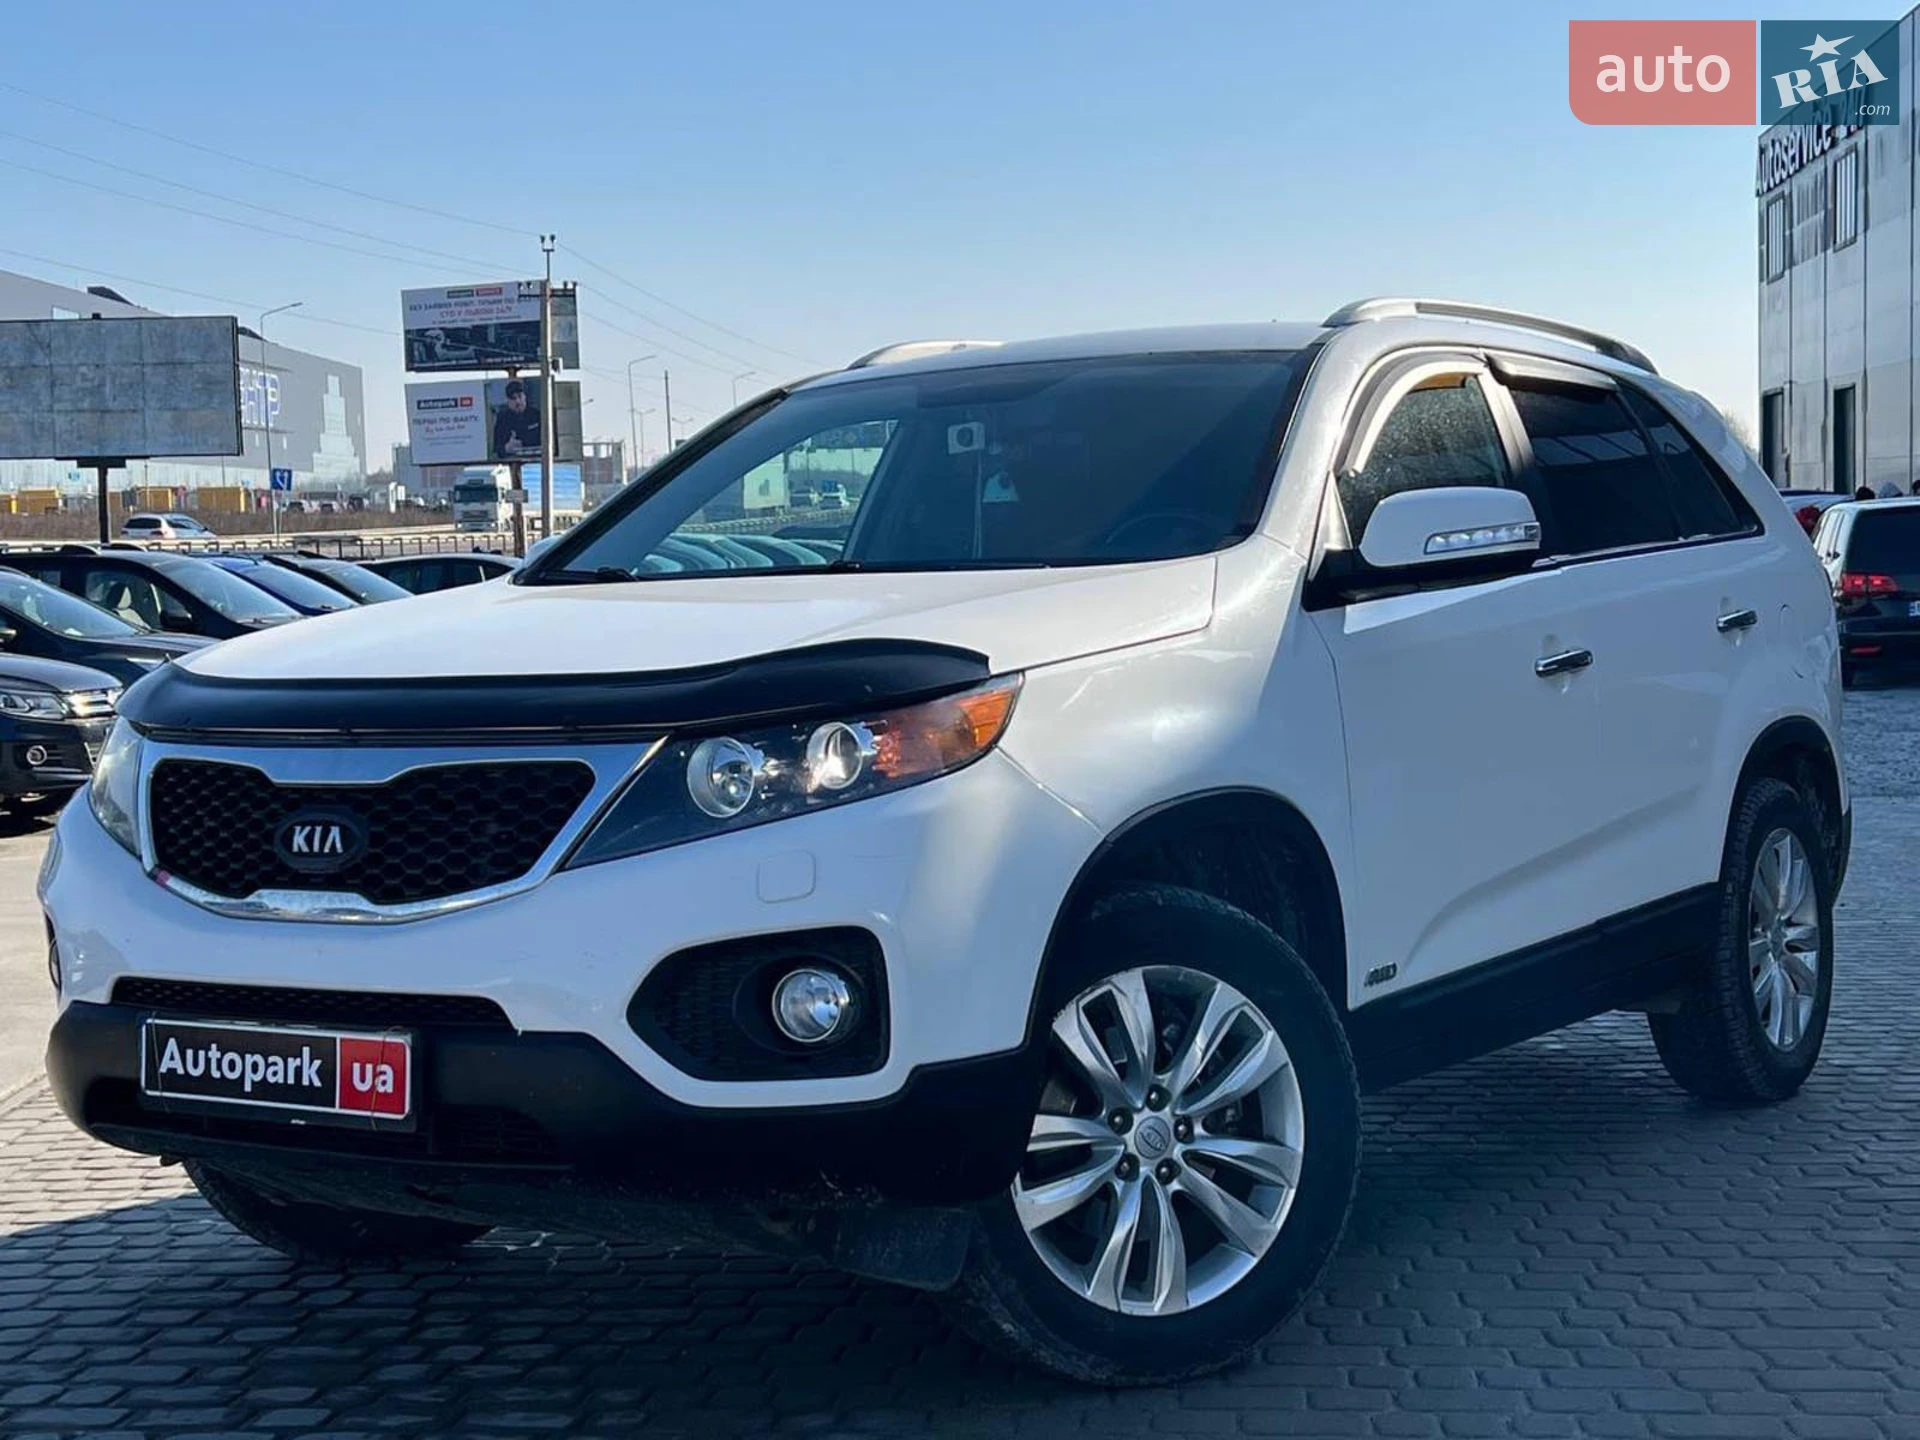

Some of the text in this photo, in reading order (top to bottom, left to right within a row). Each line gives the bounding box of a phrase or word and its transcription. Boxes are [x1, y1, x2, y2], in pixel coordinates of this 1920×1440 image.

[292, 825, 343, 853] KIA
[160, 1037, 394, 1093] Autopark ua
